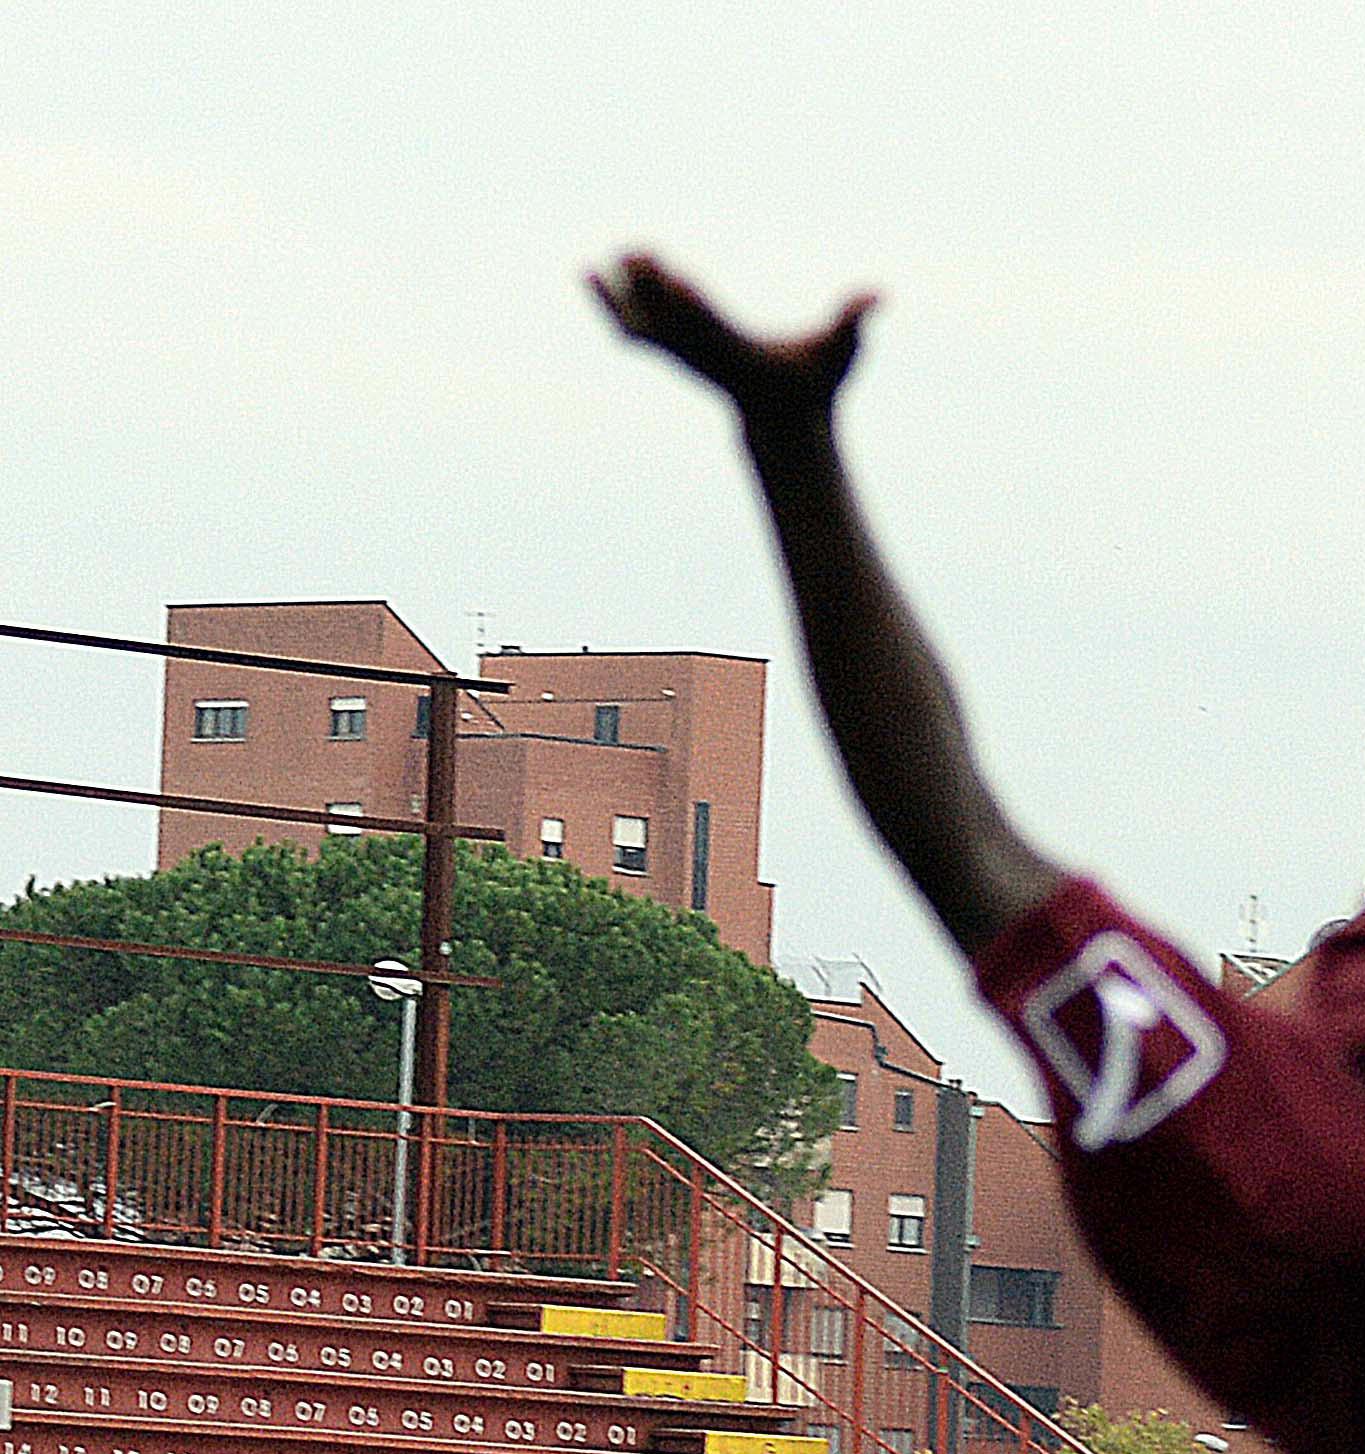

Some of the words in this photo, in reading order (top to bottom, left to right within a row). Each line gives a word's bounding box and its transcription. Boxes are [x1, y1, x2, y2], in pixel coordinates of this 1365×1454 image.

[24, 1265, 56, 1286] 09
[131, 1274, 164, 1295] 07
[238, 1283, 270, 1304] 05
[342, 1293, 372, 1314] 03
[393, 1295, 424, 1317] 02
[444, 1299, 473, 1320] 01
[2, 1323, 28, 1343] 11
[56, 1326, 86, 1347] 10
[106, 1330, 138, 1350] 09
[214, 1337, 246, 1358] 07
[320, 1346, 351, 1367] 05
[423, 1356, 454, 1378] 03
[475, 1358, 506, 1380] 02
[526, 1362, 555, 1383] 01
[30, 1383, 59, 1405] 12
[84, 1386, 110, 1407] 11
[137, 1390, 167, 1411] 10
[187, 1394, 219, 1415] 09
[295, 1401, 327, 1422] 07
[401, 1410, 433, 1431] 05
[504, 1420, 535, 1441] 03
[556, 1421, 587, 1443] 02
[607, 1425, 636, 1445] 01
